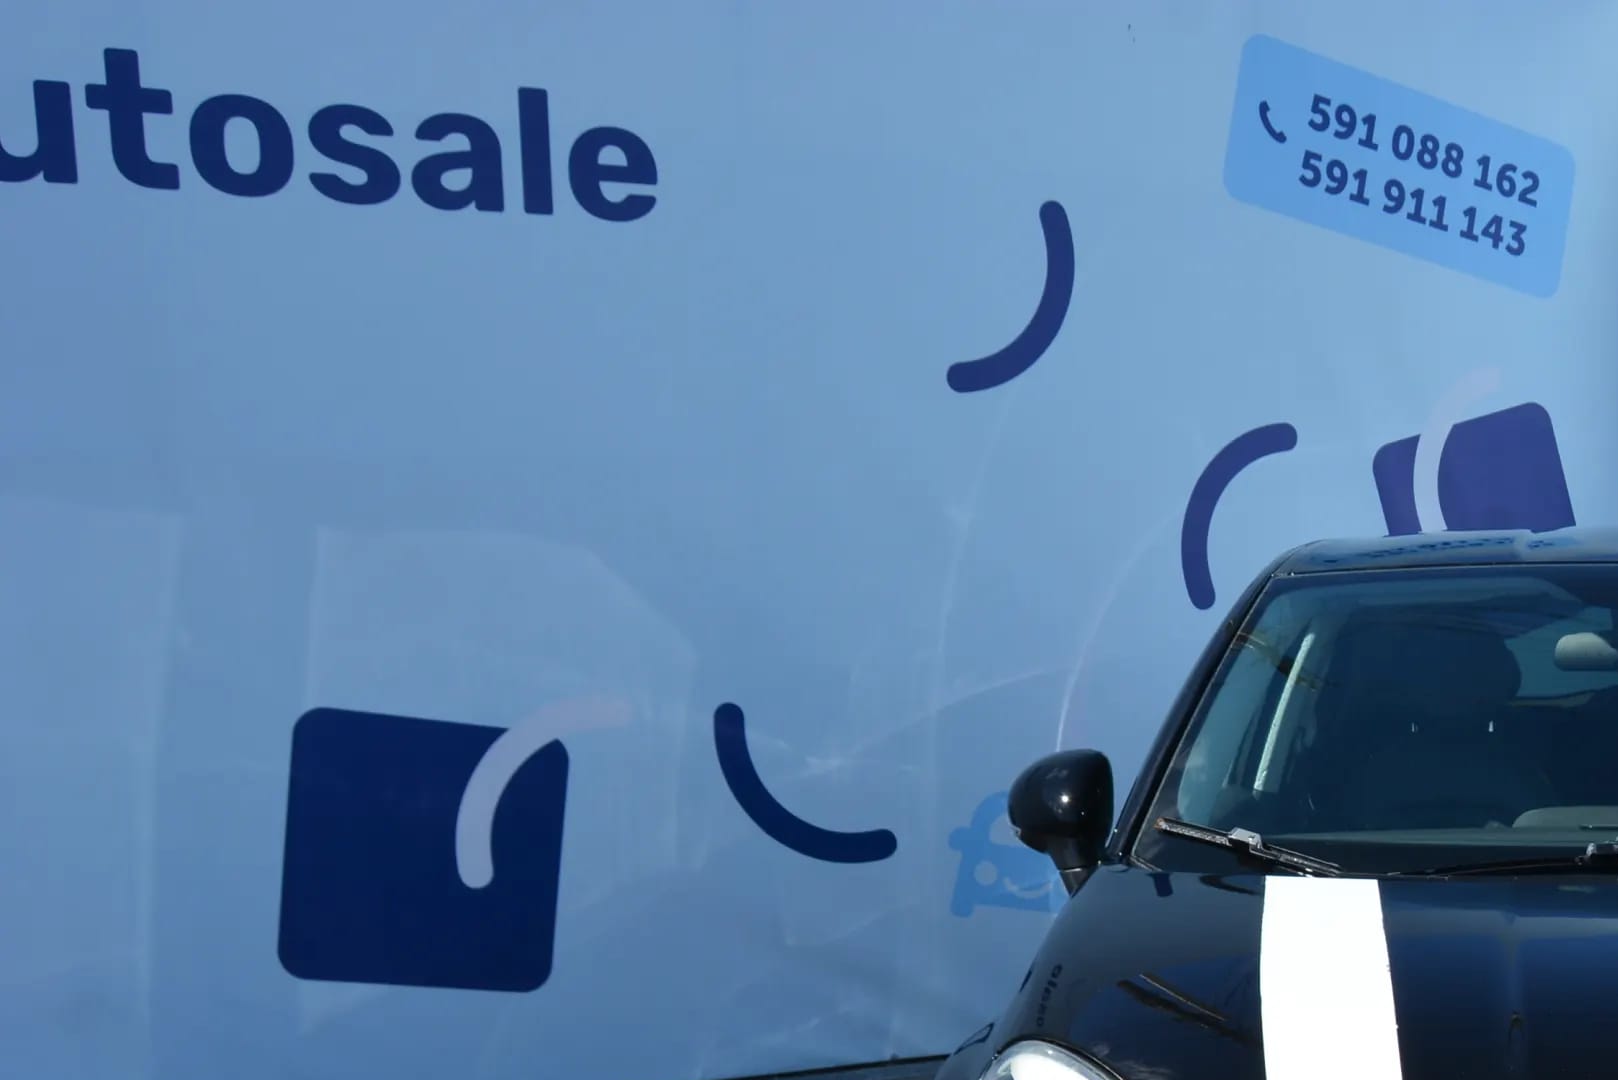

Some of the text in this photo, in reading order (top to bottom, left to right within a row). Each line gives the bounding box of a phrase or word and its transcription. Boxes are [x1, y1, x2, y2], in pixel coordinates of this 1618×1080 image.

[1298, 149, 1527, 257] 591 911 143
[1307, 93, 1540, 208] 591 088 162
